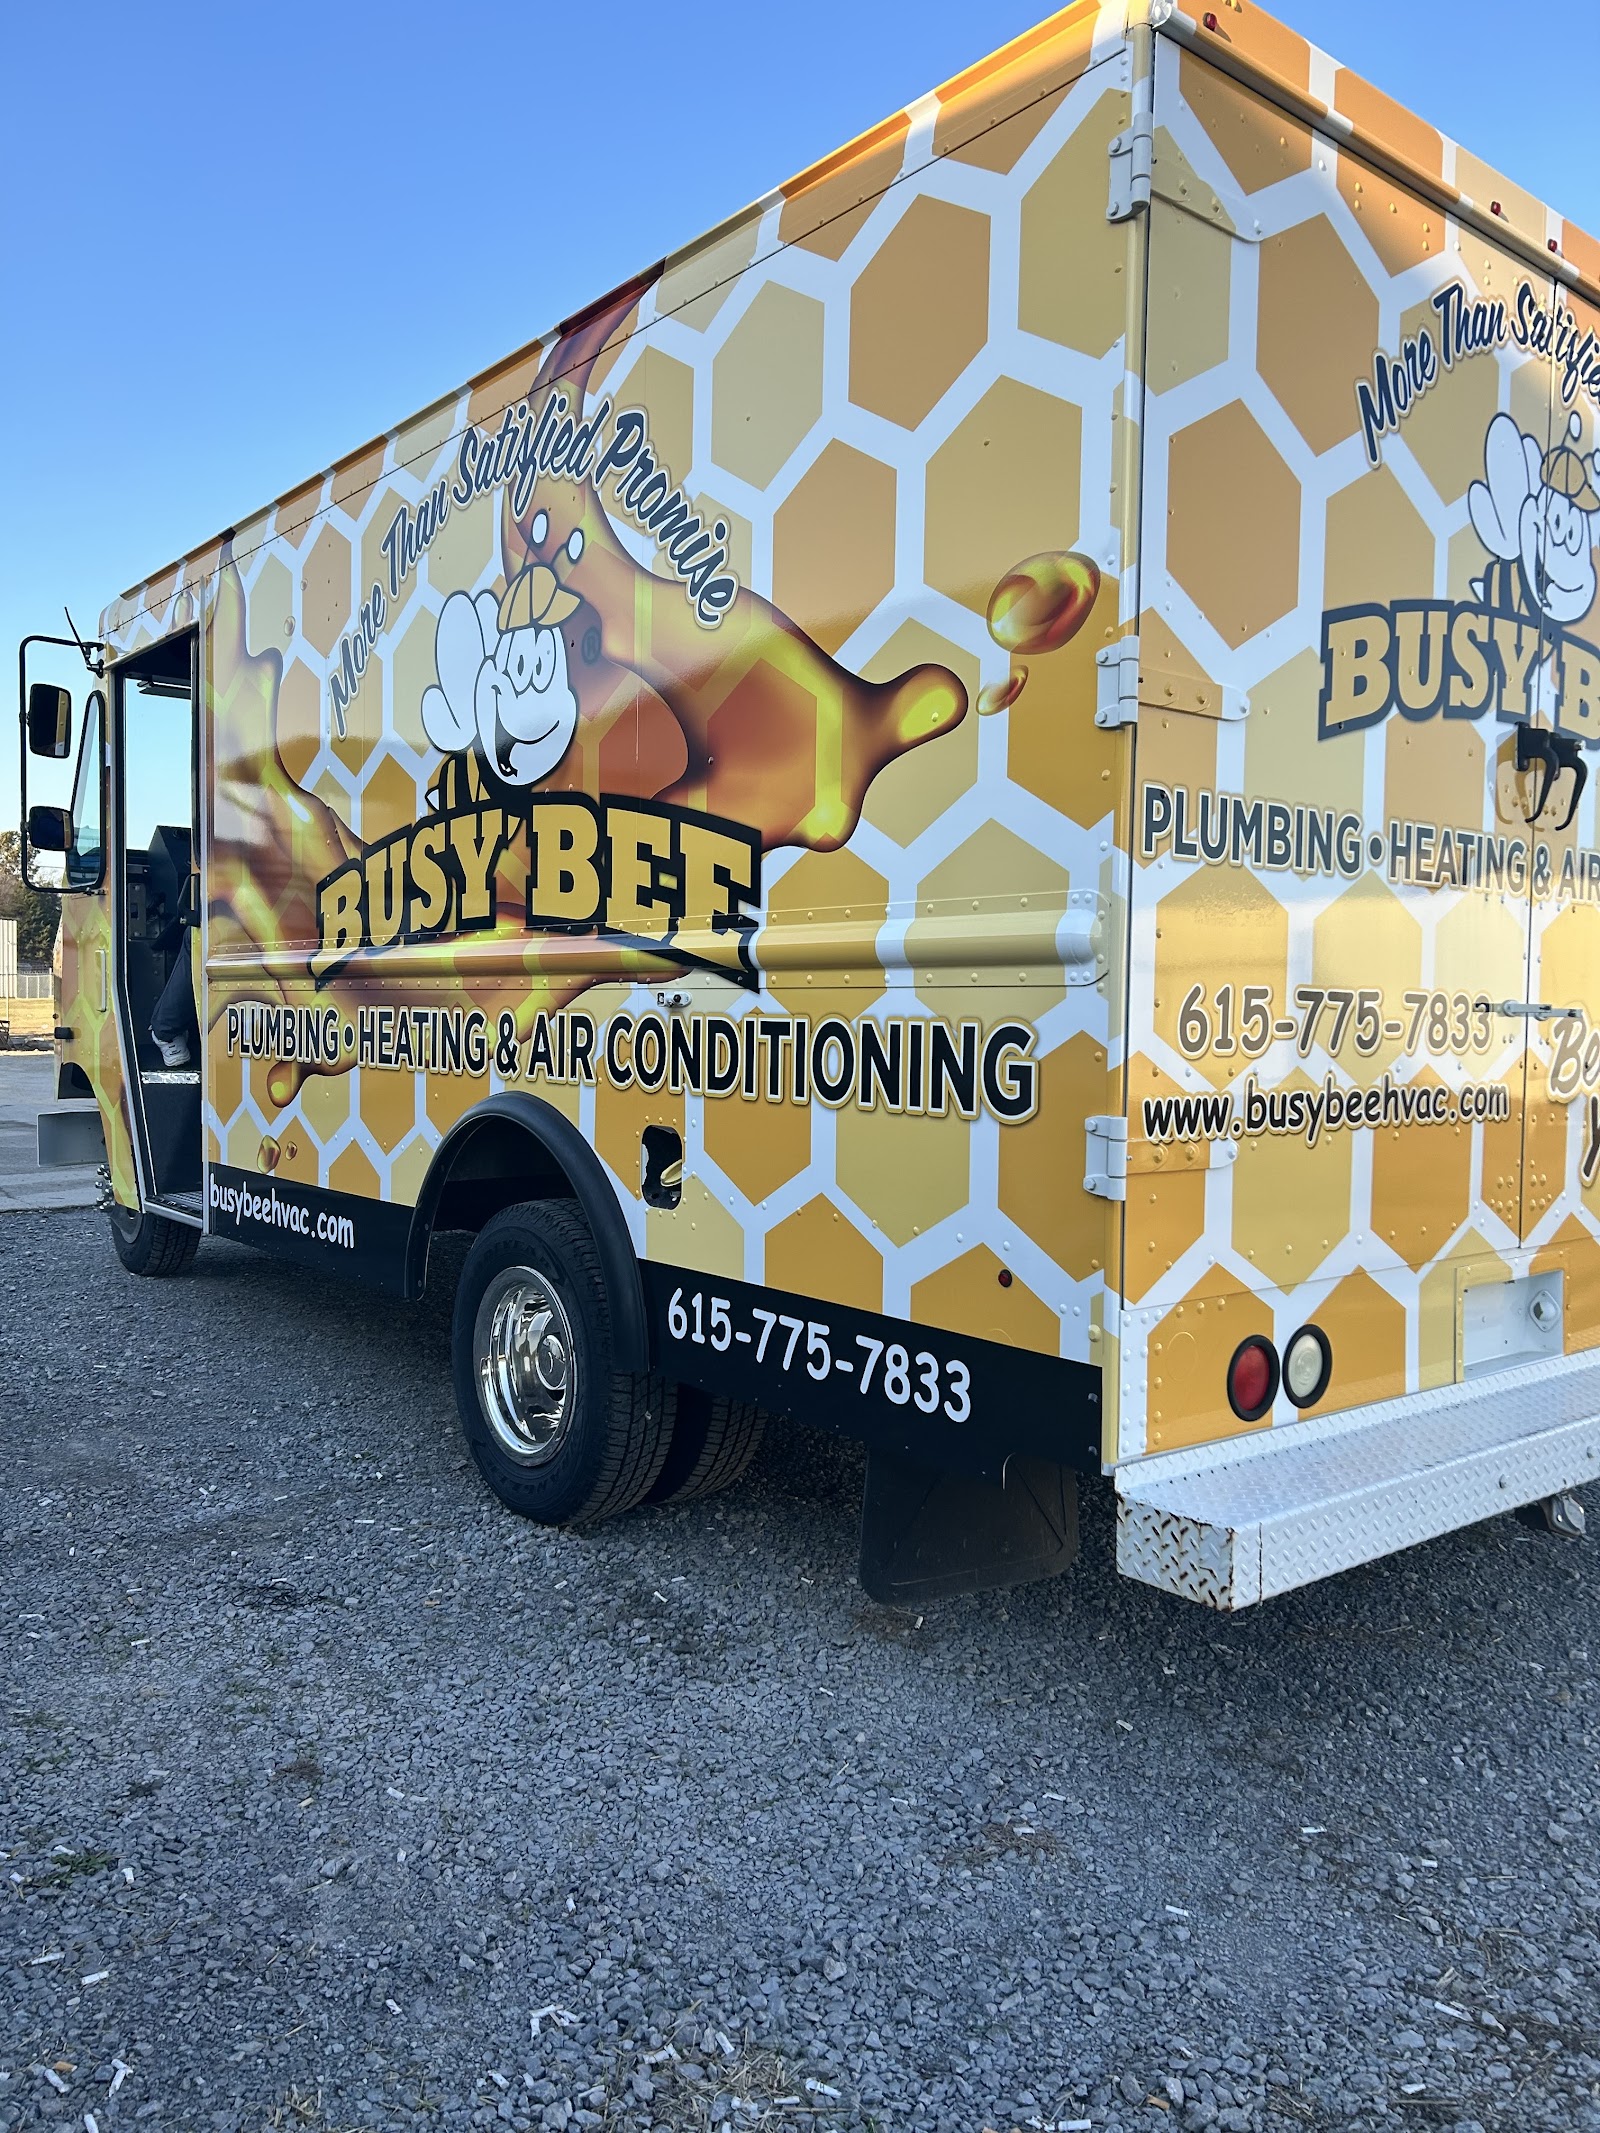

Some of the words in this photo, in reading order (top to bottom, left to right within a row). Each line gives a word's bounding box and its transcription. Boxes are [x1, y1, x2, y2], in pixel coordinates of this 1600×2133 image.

[1358, 339, 1436, 463] More
[1434, 282, 1507, 367] Than
[1510, 282, 1600, 403] Satisfie
[330, 583, 384, 736] More
[382, 480, 448, 596] Than
[452, 392, 610, 521] Satisfied
[595, 411, 737, 622] Promise
[1323, 608, 1542, 729] BUSY
[310, 807, 504, 978] BUSY
[530, 803, 753, 976] BEE
[1532, 844, 1552, 897] &
[1557, 849, 1600, 902] AIR
[497, 1010, 520, 1079] &
[527, 1011, 596, 1085] AIR
[607, 1014, 1035, 1117] CONDITIONING
[1178, 984, 1493, 1056] 615-775-7833
[1143, 1075, 1509, 1144] www.busybeehvac.com
[209, 1172, 355, 1250] busybeehvac.com
[667, 1287, 972, 1423] 615-775-7833
